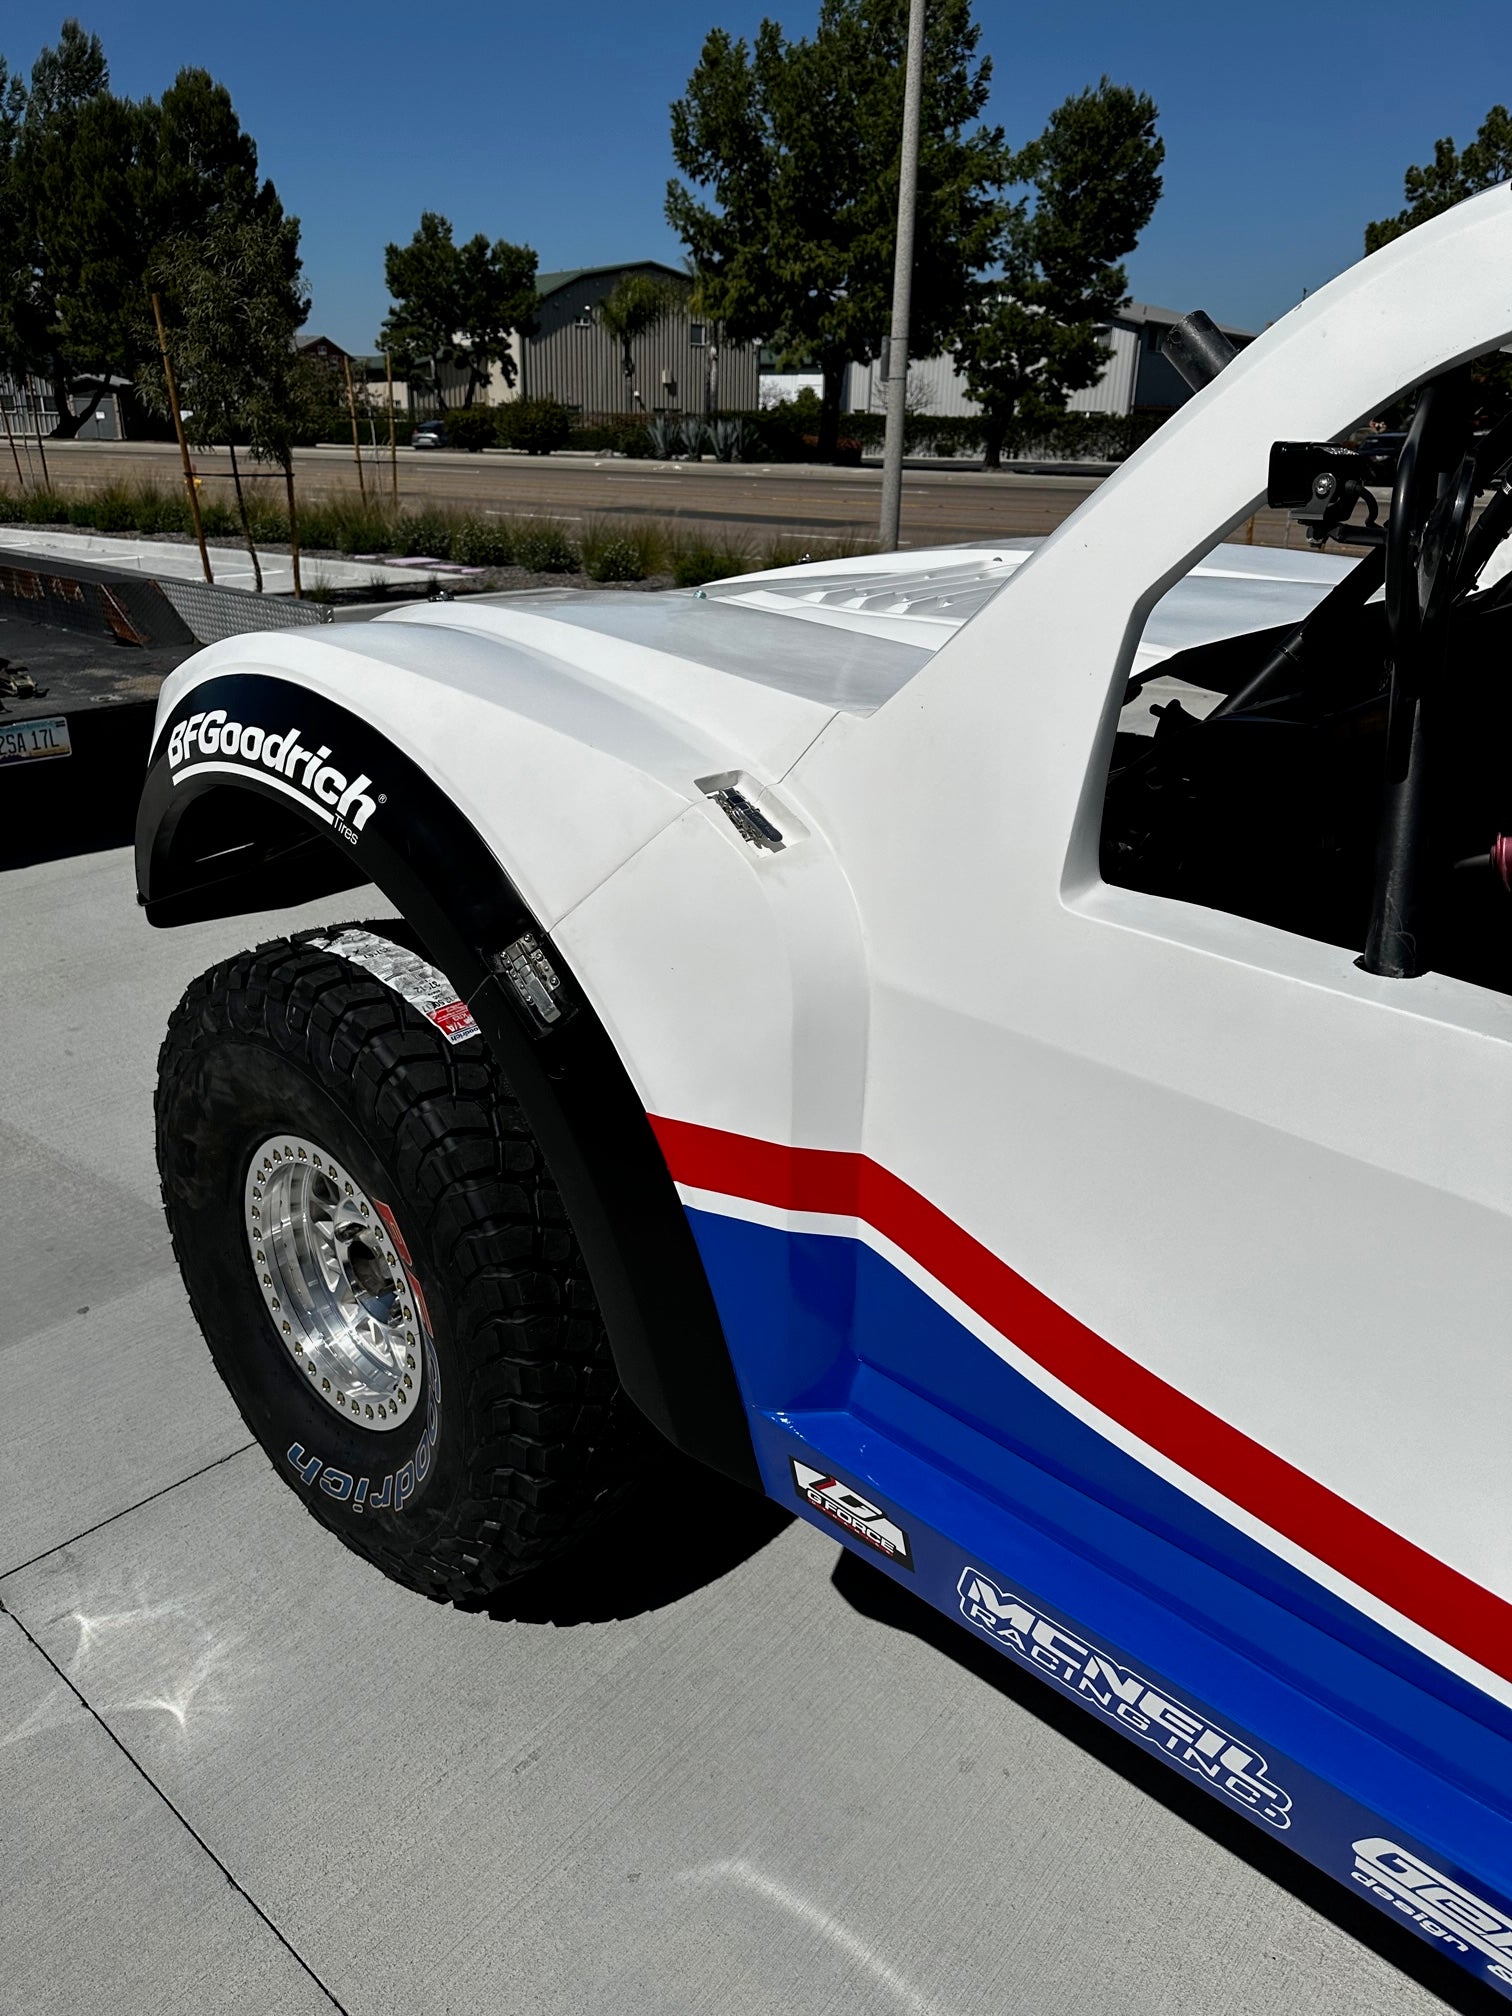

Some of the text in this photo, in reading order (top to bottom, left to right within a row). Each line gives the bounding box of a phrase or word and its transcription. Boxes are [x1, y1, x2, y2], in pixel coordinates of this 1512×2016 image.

[31, 728, 60, 751] 17L
[167, 710, 376, 831] BFGoodrich
[334, 812, 359, 845] Tires
[970, 1603, 1151, 1731] RACING
[1351, 1871, 1469, 1952] design
